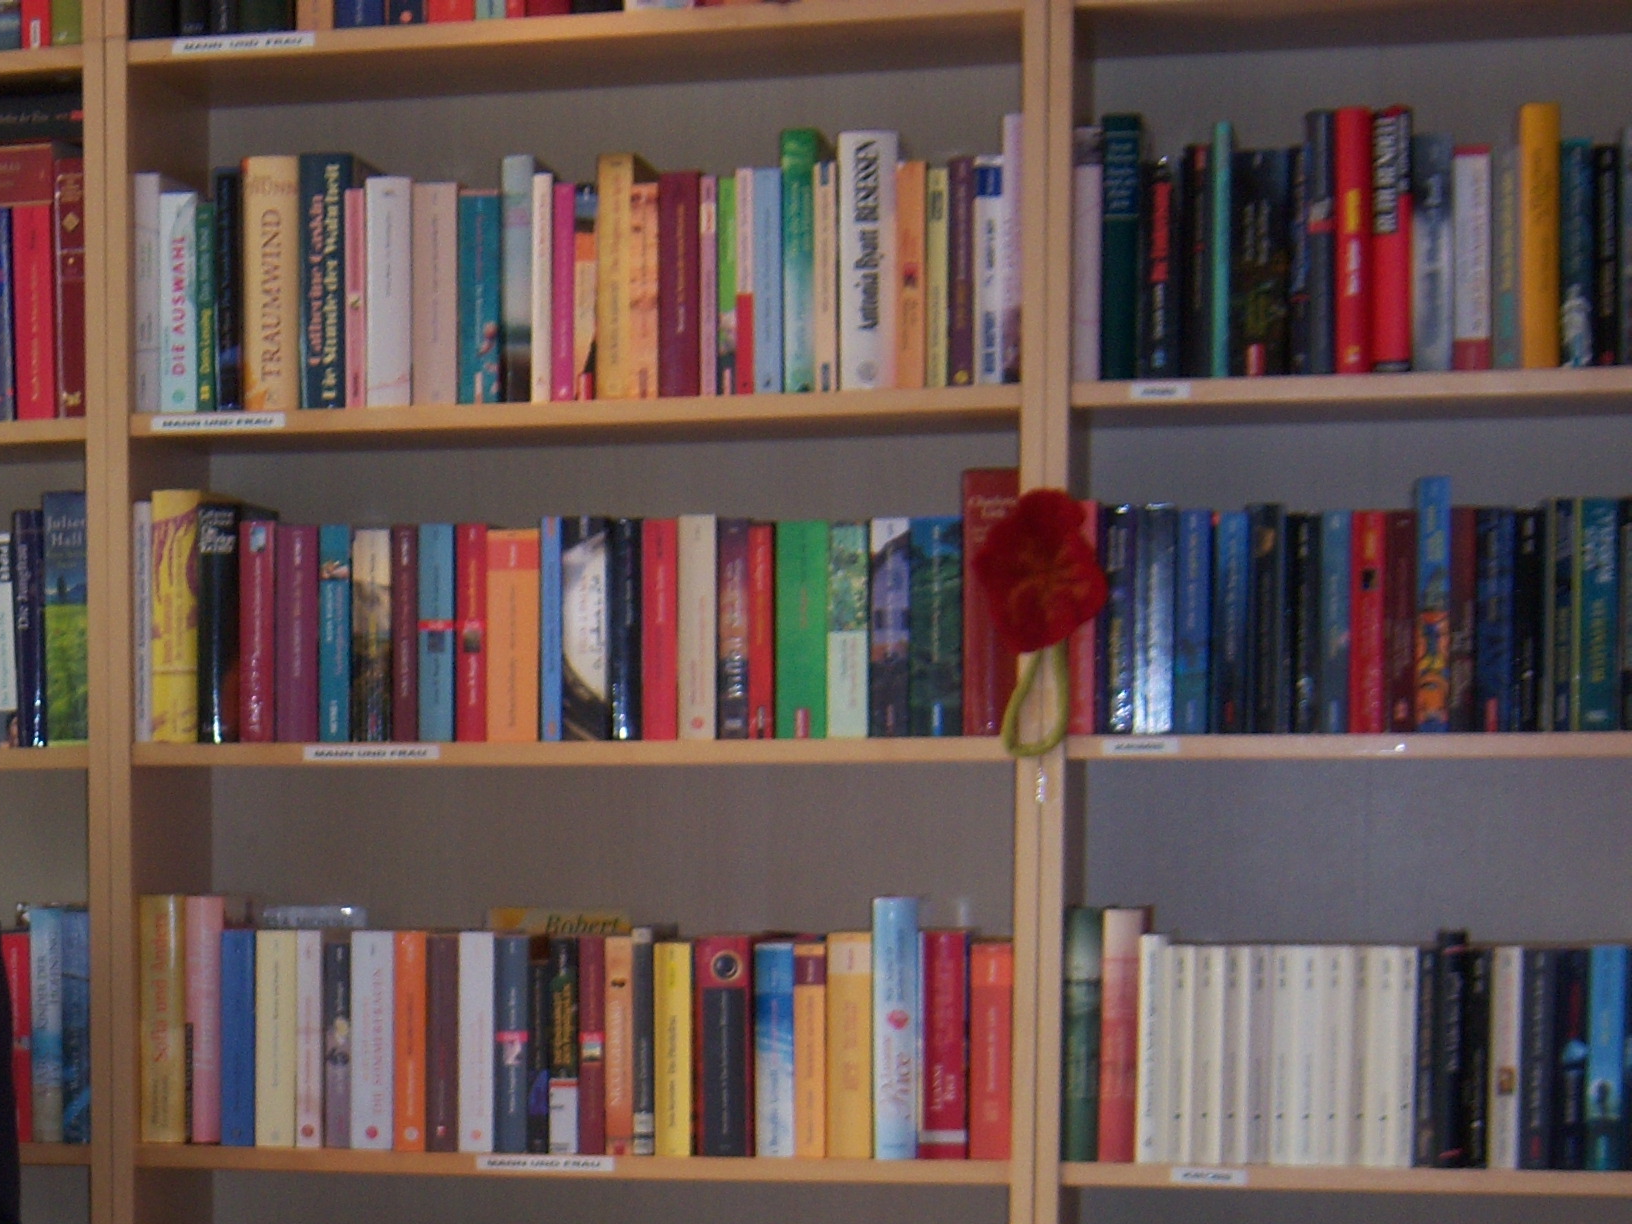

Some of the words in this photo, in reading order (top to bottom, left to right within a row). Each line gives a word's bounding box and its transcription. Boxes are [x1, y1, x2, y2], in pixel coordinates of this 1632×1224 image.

[184, 42, 222, 51] MANN
[230, 40, 258, 48] UND
[266, 37, 302, 46] FRAU
[853, 140, 879, 224] BESESSEN
[307, 194, 324, 263] Gaskin
[322, 162, 340, 254] Wahrheit
[852, 229, 884, 270] Byatt
[171, 235, 186, 335] AUSWAHL
[323, 259, 338, 290] der
[260, 208, 282, 383] TRAUMWIND
[853, 272, 879, 332] Antonia
[308, 266, 324, 367] Catherine
[172, 344, 185, 377] DIE
[162, 418, 201, 428] MANN
[204, 418, 233, 427] UND
[237, 416, 273, 426] FRAU
[314, 749, 353, 759] MANN
[357, 749, 386, 758] UND
[390, 748, 427, 758] FRAU
[152, 912, 167, 972] Anders
[545, 915, 621, 935] Robert
[152, 979, 167, 1013] und
[487, 1159, 524, 1169] MANN
[530, 1158, 560, 1169] UND
[565, 1158, 602, 1168] FRAU
